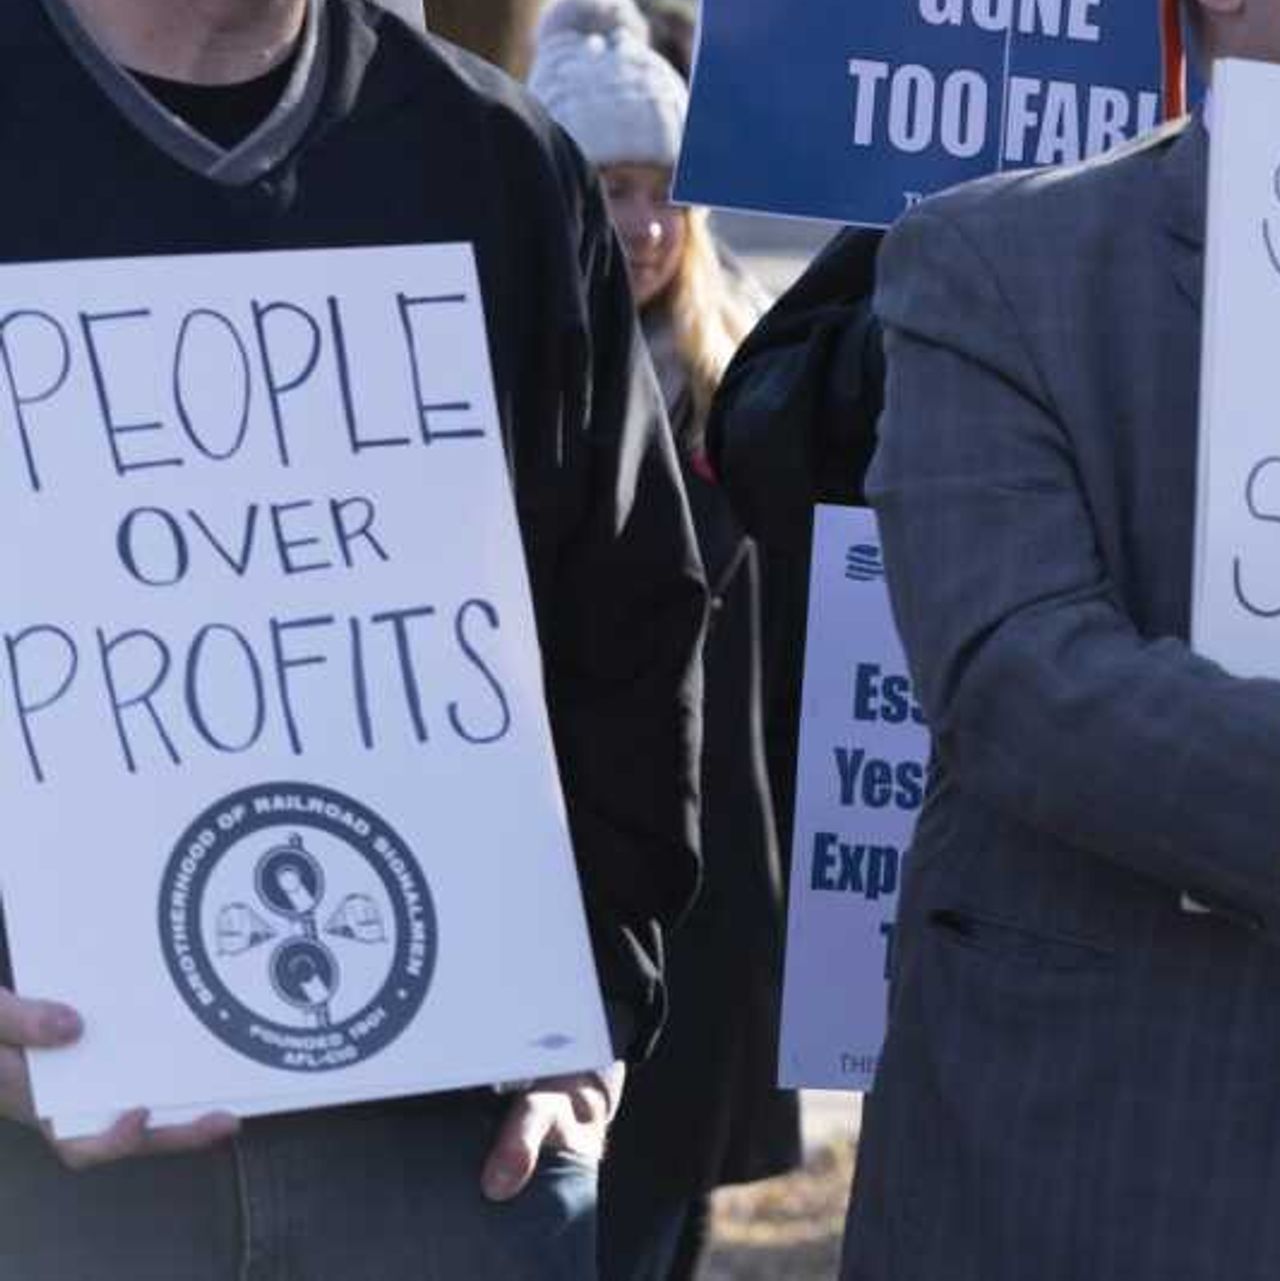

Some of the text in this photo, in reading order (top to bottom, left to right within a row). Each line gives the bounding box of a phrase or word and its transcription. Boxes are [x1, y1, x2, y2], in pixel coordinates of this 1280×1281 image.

[848, 58, 988, 160] TOO
[0, 292, 485, 492] PEOPLE
[117, 495, 387, 586] OVER
[4, 598, 510, 784] PROFITS
[171, 795, 425, 1007] BROTHERHOOD OF RAILROAD SIGNALMEN
[840, 1053, 880, 1073] THI
